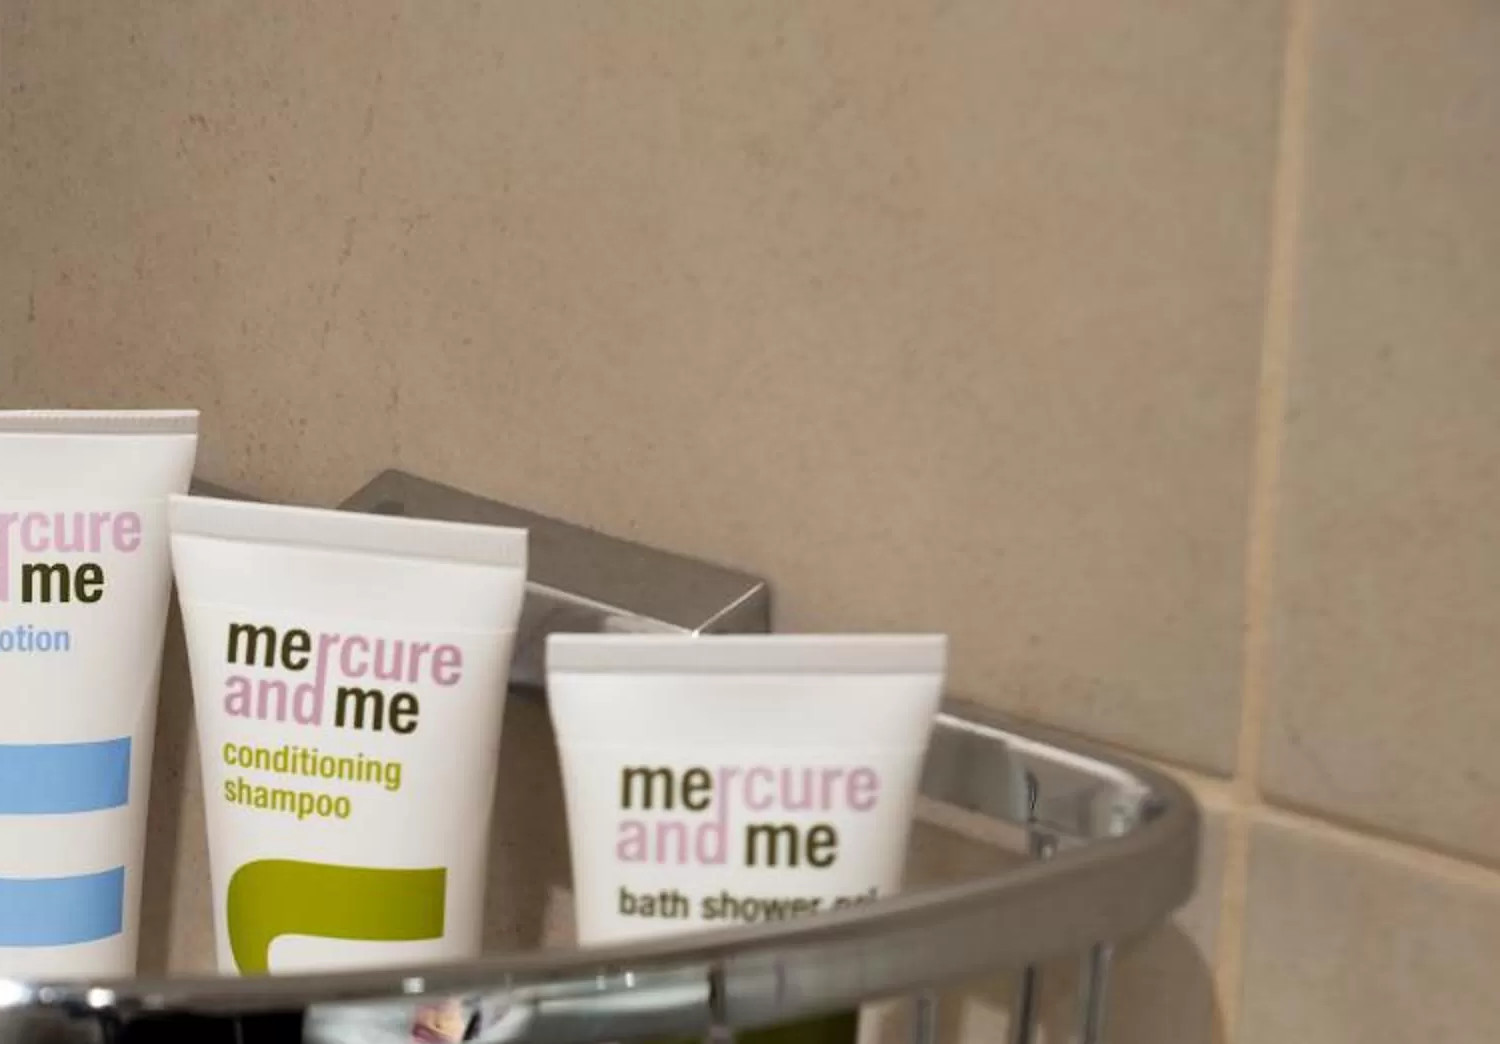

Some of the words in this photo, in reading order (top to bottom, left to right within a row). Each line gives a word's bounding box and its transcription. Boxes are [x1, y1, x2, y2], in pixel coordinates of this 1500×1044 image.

[20, 562, 105, 604] me
[226, 622, 464, 687] mercure
[223, 672, 324, 728] and
[333, 685, 421, 735] me
[222, 741, 404, 793] conditioning
[619, 763, 883, 812] mercure
[223, 776, 352, 822] shampoo
[614, 813, 729, 866] and
[743, 821, 840, 869] me
[617, 885, 690, 920] bath
[700, 888, 821, 922] shower
